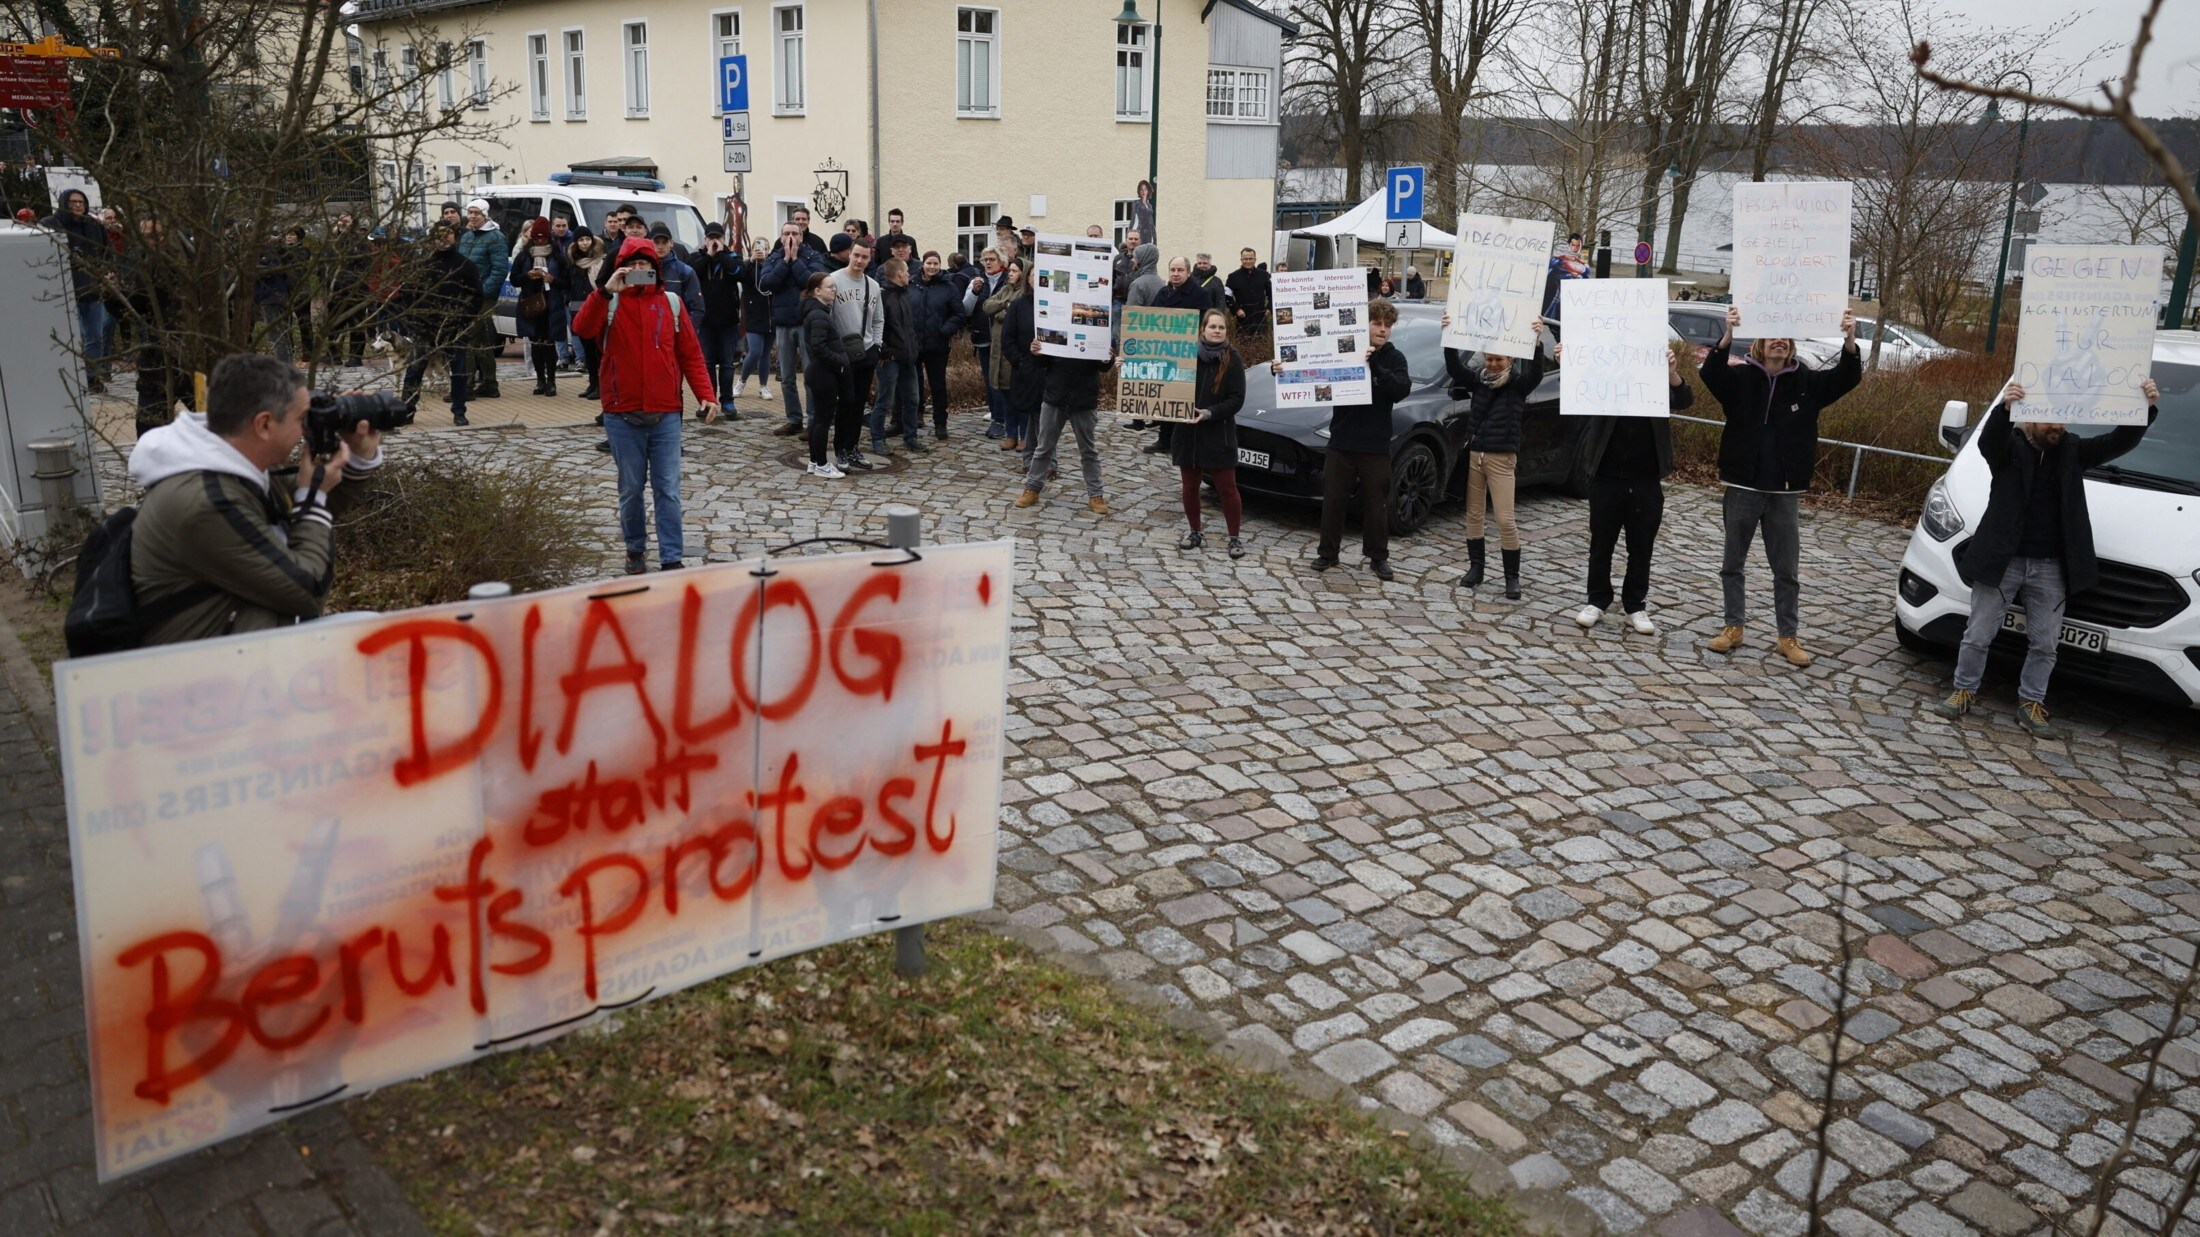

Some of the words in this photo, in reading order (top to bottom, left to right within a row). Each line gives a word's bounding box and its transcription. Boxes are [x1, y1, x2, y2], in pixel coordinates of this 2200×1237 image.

[726, 63, 741, 104] P
[1394, 174, 1415, 213] P
[1738, 199, 1780, 212] TESLA
[1795, 199, 1838, 213] WIRD
[1770, 217, 1804, 231] HIER
[1464, 230, 1548, 253] IDEOLOGIE
[1740, 236, 1817, 250] GEZIELT
[1454, 255, 1545, 298] KILLT
[2031, 256, 2142, 281] GEGEN
[1327, 284, 1365, 292] behindern?
[1769, 272, 1799, 287] UND
[836, 288, 860, 304] NIKE
[1274, 300, 1312, 308] Erdölindustrie
[1331, 300, 1368, 308] Autoindustrie
[1568, 288, 1655, 309] WENN
[1742, 292, 1826, 306] SCHLECHT
[1458, 300, 1518, 332] HIRN
[1756, 312, 1838, 324] GEMACHT
[2024, 303, 2157, 318] AGAINSTERTUM
[1127, 312, 1200, 335] ZUKUNFT
[1326, 328, 1366, 336] Kohleindustrie
[1591, 316, 1634, 332] DER
[2054, 325, 2117, 351] FÜR
[1123, 338, 1198, 359] GESTALTEN
[1566, 344, 1668, 367] VERSTAND
[1120, 360, 1168, 380] NICHT
[2018, 361, 2147, 390] DIALOG
[1122, 382, 1164, 398] BLEIBT
[1282, 391, 1310, 400] WTF?!
[1120, 398, 1149, 416] BEIM
[1152, 401, 1194, 420] ALTEN
[1240, 450, 1251, 463] PJ
[1252, 452, 1268, 466] 15E
[2004, 612, 2016, 628] B
[356, 574, 903, 788] DIALOG
[522, 742, 718, 848] statt
